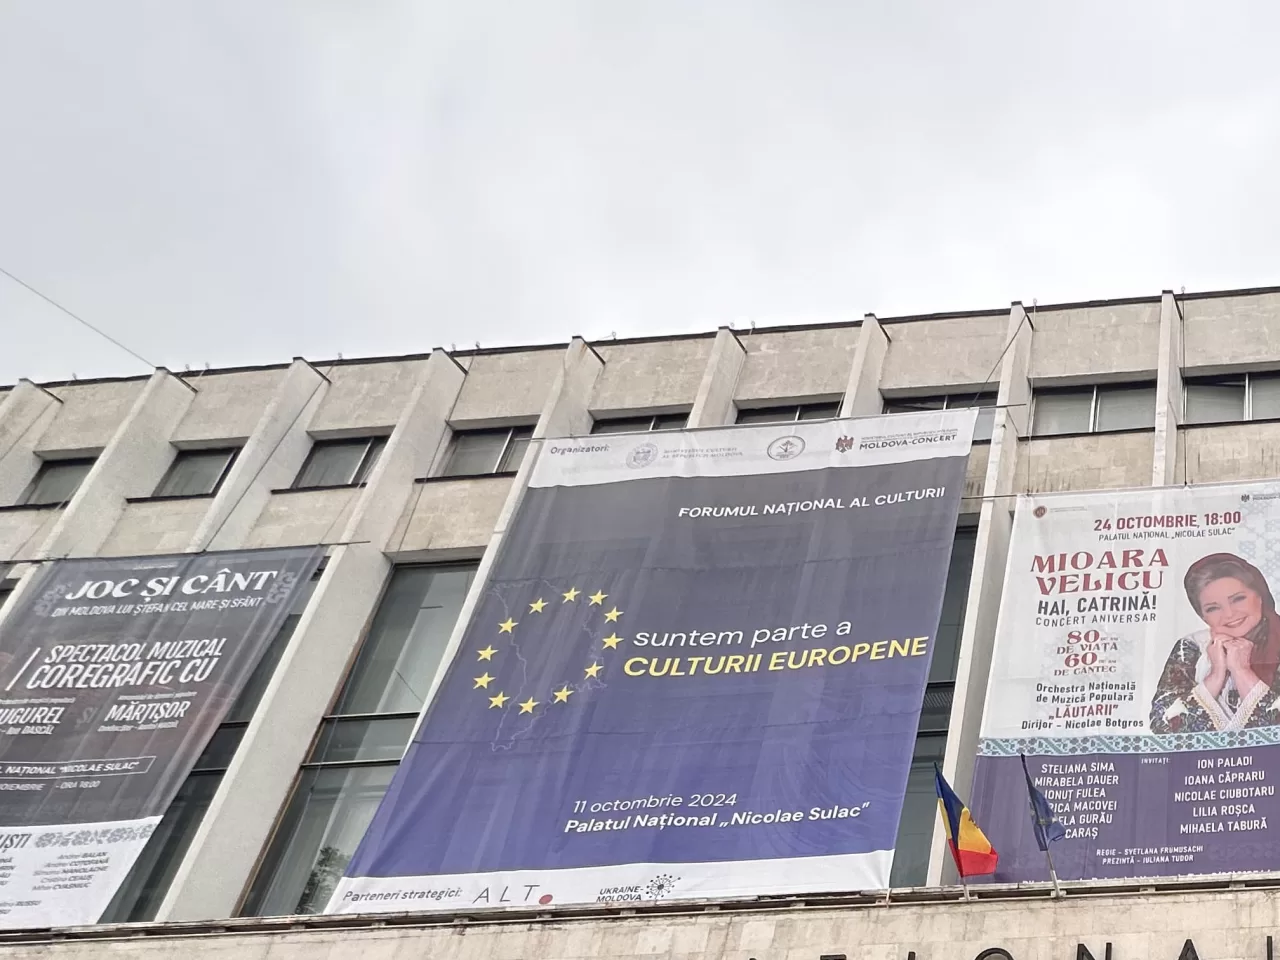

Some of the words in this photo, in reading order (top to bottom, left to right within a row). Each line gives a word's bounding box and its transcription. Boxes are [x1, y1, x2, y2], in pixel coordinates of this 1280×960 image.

[859, 434, 957, 450] MOLDOVA-CONCERT
[549, 445, 611, 456] Organizatori:
[678, 506, 758, 518] FORUMUL
[763, 498, 845, 516] NAȚIONAL
[849, 497, 870, 508] AL
[874, 487, 946, 506] CULTURII
[1094, 518, 1111, 532] 24
[1116, 514, 1200, 530] OCTOMBRIE,
[1204, 511, 1241, 526] 18:00
[1098, 532, 1130, 541] PALATUL
[1030, 548, 1169, 574] MIOARA
[65, 579, 140, 600] JOC
[140, 576, 181, 603] ȘI
[182, 568, 277, 596] CÂNT
[1036, 571, 1163, 595] VELICU
[51, 607, 70, 617] DIN
[71, 605, 116, 615] MOLDOVA
[116, 604, 133, 614] LUI
[170, 601, 188, 612] CEL
[190, 600, 219, 611] MARE
[230, 596, 263, 608] SFÂNT
[1037, 599, 1070, 616] HAI,
[1077, 591, 1157, 613] CATRINĂ!
[1035, 615, 1086, 627] CONCERT
[1092, 612, 1157, 624] ANIVERSAR
[633, 627, 744, 647] suntem
[751, 620, 828, 648] parte
[835, 621, 852, 636] a
[1067, 629, 1100, 644] 80
[45, 642, 147, 664] SPECTACOL
[149, 638, 227, 660] MUZICAL
[623, 653, 763, 676] CULTURII
[768, 636, 929, 671] EUROPENE
[1056, 646, 1075, 655] DE
[1064, 652, 1098, 668] 60
[27, 660, 182, 689] COREGRAFIC
[179, 657, 219, 682] CU
[1036, 682, 1085, 693] Orchestra
[1088, 681, 1136, 693] Națională
[1036, 693, 1048, 703] de
[1052, 693, 1085, 704] Muzică
[1089, 692, 1134, 702] Populară
[1021, 719, 1053, 730] Dirijor
[1065, 719, 1102, 729] Nicolae
[1105, 717, 1144, 729] Botgros
[1041, 763, 1087, 774] STELIANA
[1090, 762, 1115, 772] SIMA
[1197, 759, 1214, 769] ION
[1217, 756, 1253, 768] PALADI
[60, 781, 78, 789] ORA
[1034, 775, 1084, 787] MIRABELA
[1087, 774, 1119, 785] DAUER
[1184, 775, 1215, 786] IOANA
[1218, 770, 1265, 784] CĂPRARU
[1076, 788, 1106, 799] FULEA
[1174, 790, 1216, 802] NICOLAE
[1219, 786, 1275, 799] CIUBOTARU
[573, 800, 587, 813] 11
[590, 795, 683, 813] octombrie
[688, 793, 738, 808] 2024
[1074, 801, 1117, 812] MACOVEI
[1192, 806, 1218, 817] LILIA
[1221, 804, 1255, 817] ROȘCA
[564, 815, 631, 833] Palatul
[633, 812, 718, 831] Național
[1079, 811, 1113, 825] GURĂU
[1180, 822, 1224, 834] MIHAELA
[1227, 817, 1268, 831] TABURĂ
[1065, 827, 1098, 839] CARAȘ
[1124, 847, 1159, 856] SVETLANA
[1102, 856, 1134, 865] PREZINTĂ
[1143, 854, 1170, 863] IULIANA
[1172, 854, 1194, 862] TUDOR
[342, 889, 399, 902] Parteneri
[400, 888, 462, 902] strategici:
[596, 893, 643, 903] MOLDOVA
